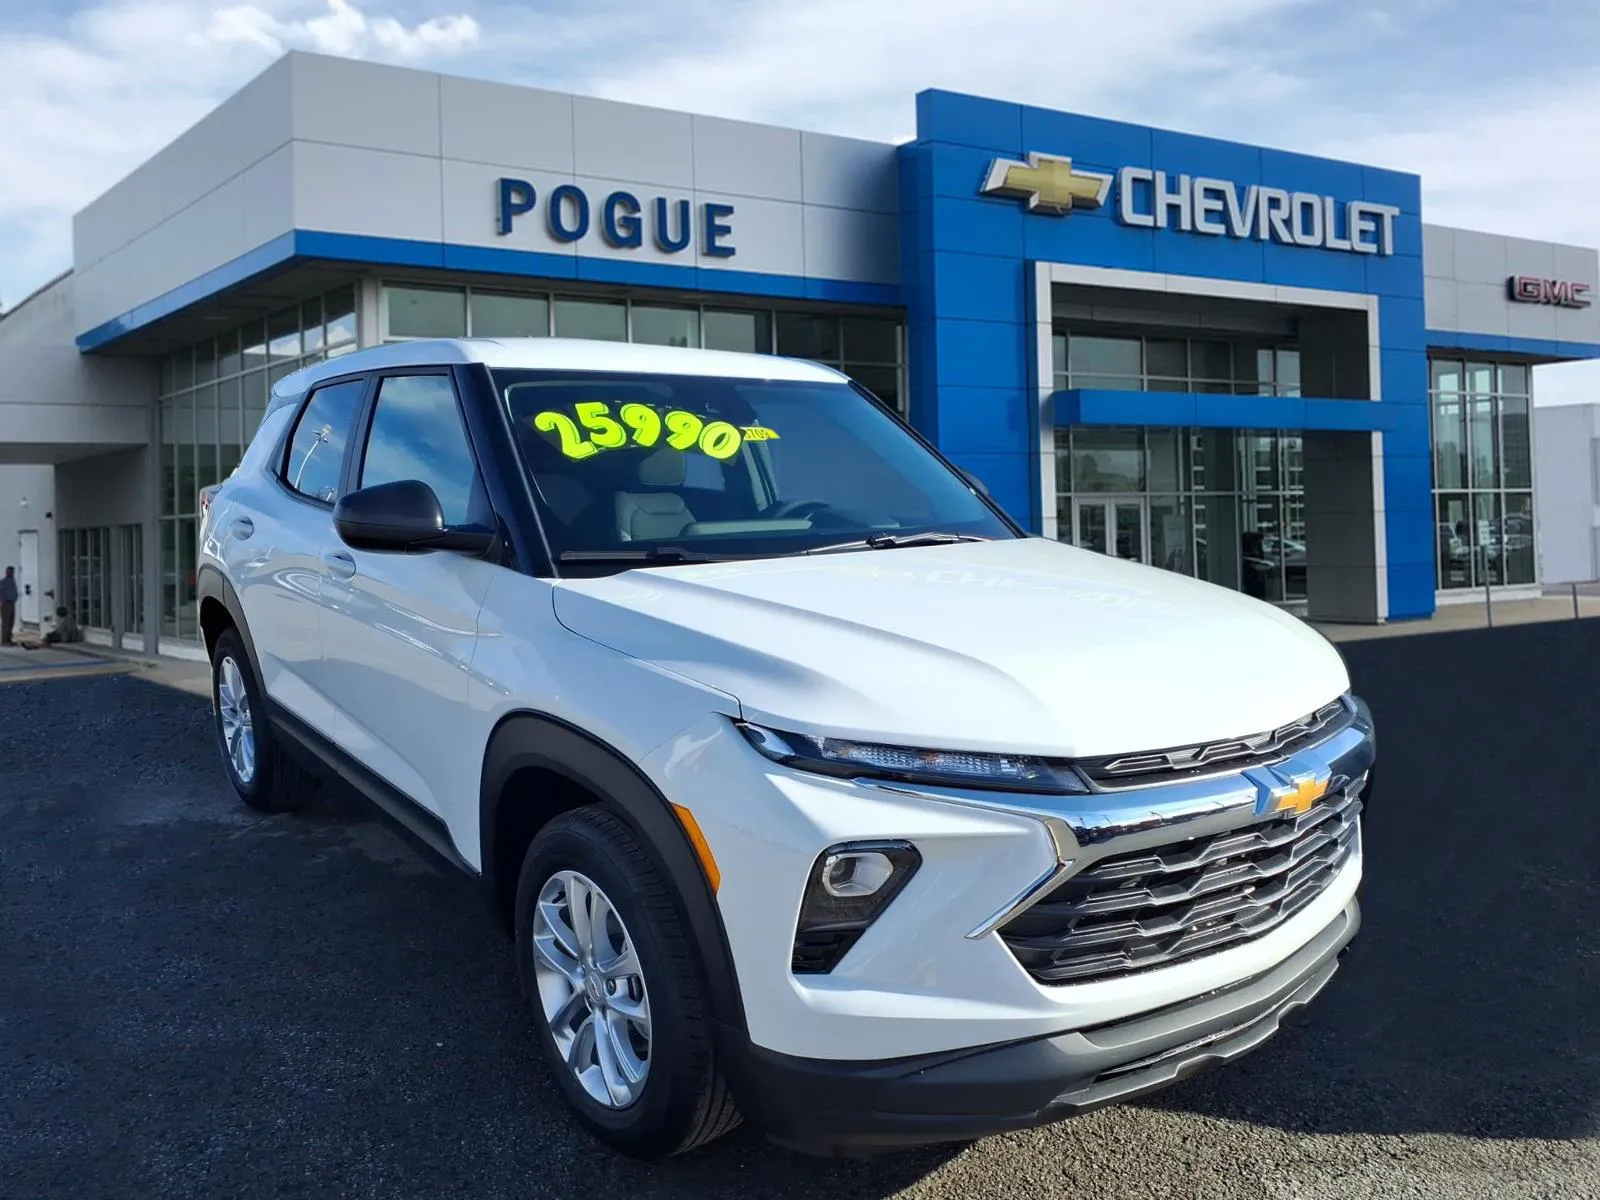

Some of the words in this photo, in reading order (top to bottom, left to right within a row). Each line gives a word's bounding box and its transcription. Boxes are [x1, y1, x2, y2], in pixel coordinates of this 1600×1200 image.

[497, 178, 736, 258] POGUE
[1117, 166, 1400, 257] CHEVROLET
[1508, 275, 1592, 309] GMC
[534, 402, 742, 460] 25990
